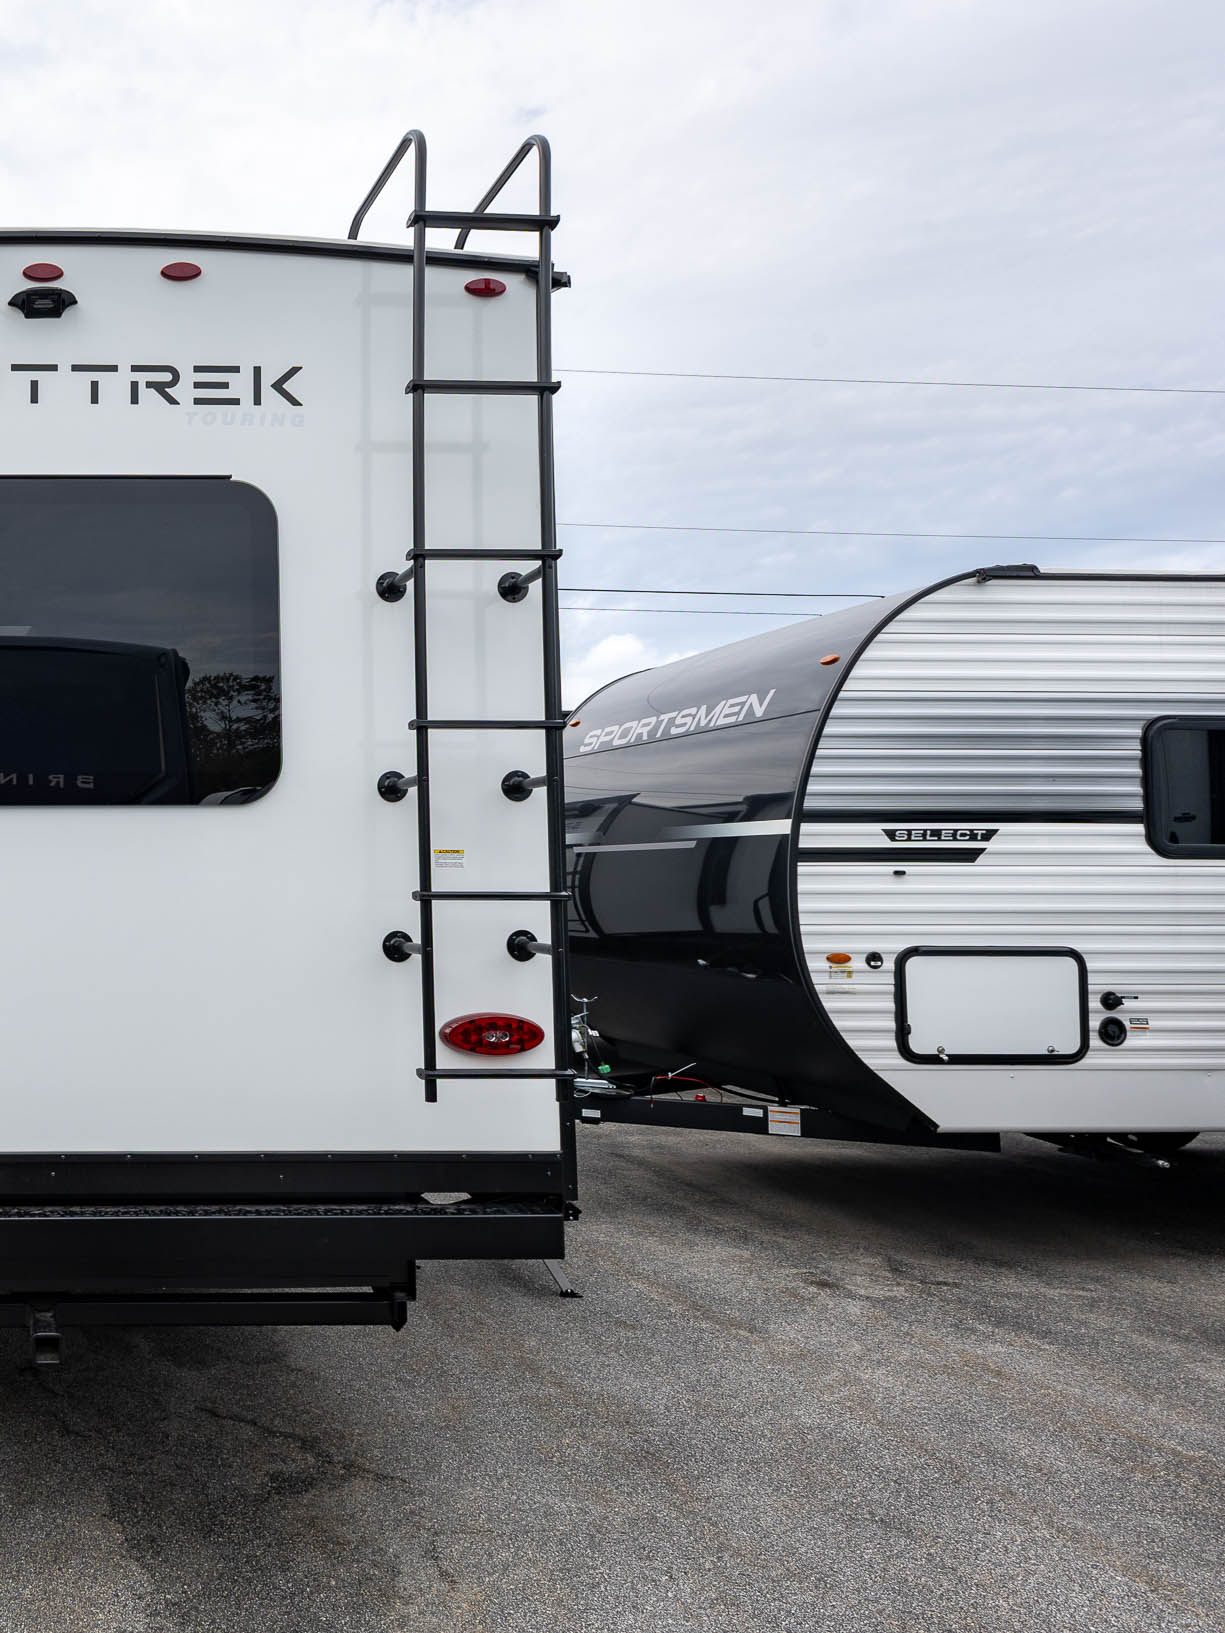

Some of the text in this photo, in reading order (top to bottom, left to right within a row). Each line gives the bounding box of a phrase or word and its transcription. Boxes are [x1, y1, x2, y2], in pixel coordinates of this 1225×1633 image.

[184, 411, 305, 427] TOURING
[579, 688, 776, 753] SPORTSMEN
[895, 830, 986, 840] SELECT
